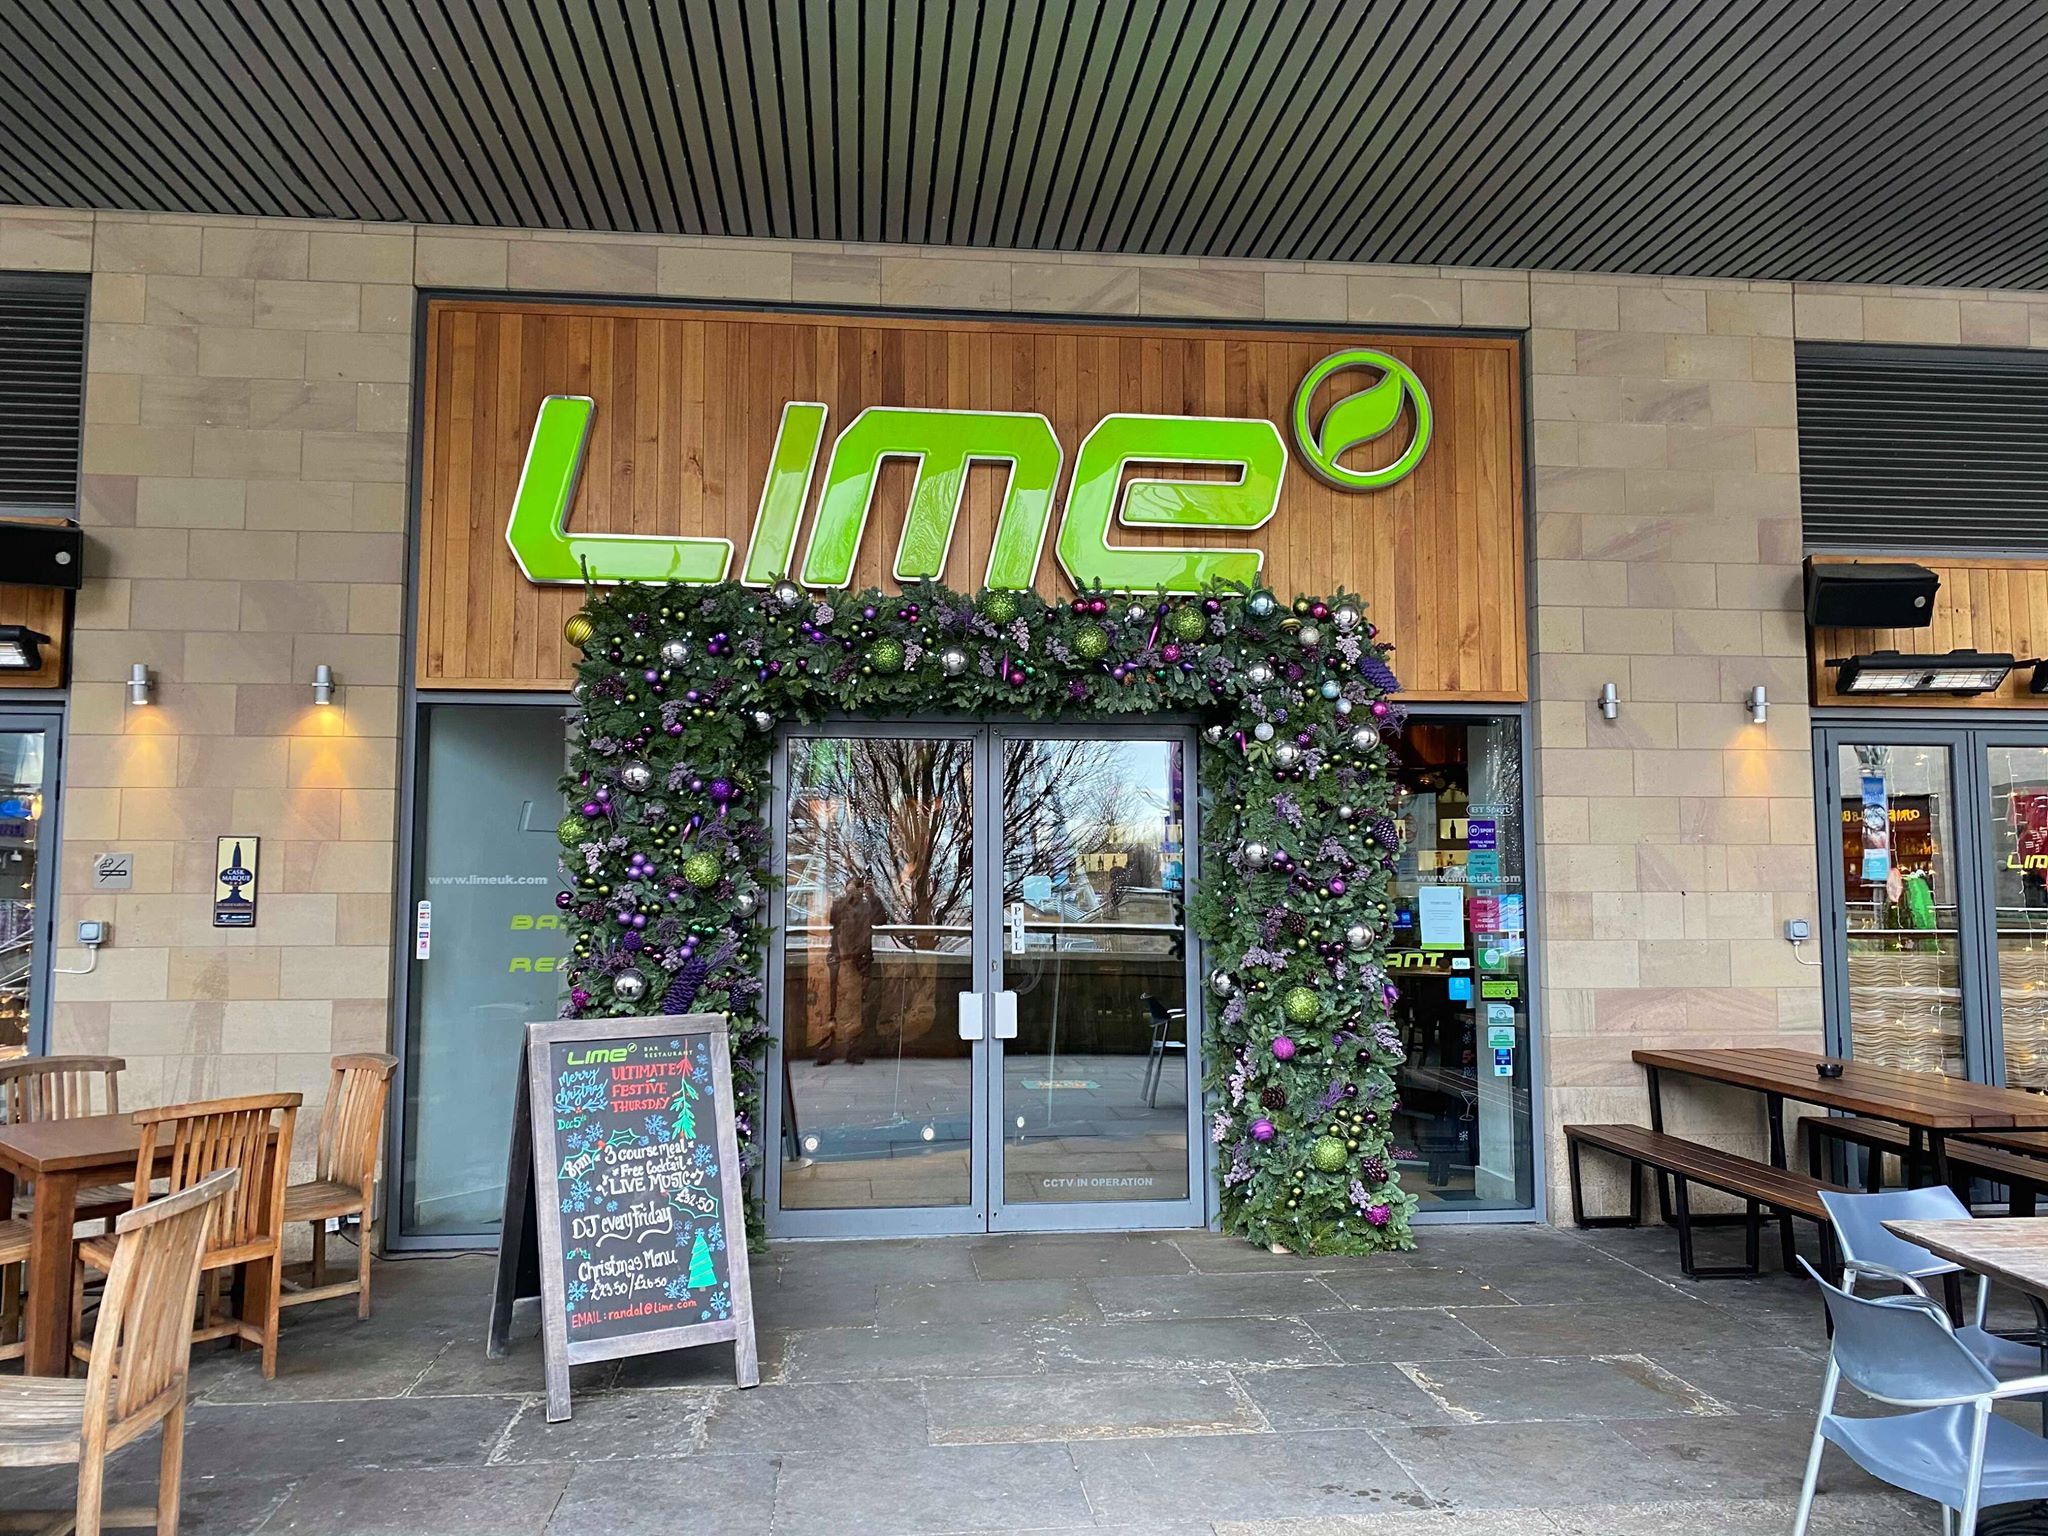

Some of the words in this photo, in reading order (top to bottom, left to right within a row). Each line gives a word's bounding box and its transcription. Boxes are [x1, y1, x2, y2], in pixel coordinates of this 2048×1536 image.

[428, 875, 548, 885] www.limeuk.com
[1416, 874, 1521, 883] www.limeuk.com
[511, 915, 567, 930] BA
[1014, 907, 1022, 951] PULL
[509, 957, 568, 973] RE
[567, 1048, 627, 1066] LIME
[644, 1050, 693, 1059] RESTAURANT
[558, 1067, 600, 1087] Merry
[611, 1063, 677, 1081] ULTIMATE
[612, 1082, 668, 1097] FESTIVE
[610, 1097, 670, 1113] THURSDAY
[604, 1145, 617, 1165] 3
[618, 1146, 659, 1162] course
[564, 1153, 592, 1178] 8pm
[620, 1164, 645, 1177] Free
[646, 1156, 687, 1175] Cocktail
[608, 1177, 645, 1195] LIVE
[1043, 1179, 1074, 1188] CCTV
[1077, 1178, 1088, 1187] IN
[1091, 1177, 1153, 1187] OPERATION
[572, 1214, 600, 1240] DJ
[578, 1255, 643, 1284] Christmas
[642, 1249, 678, 1269] Menu
